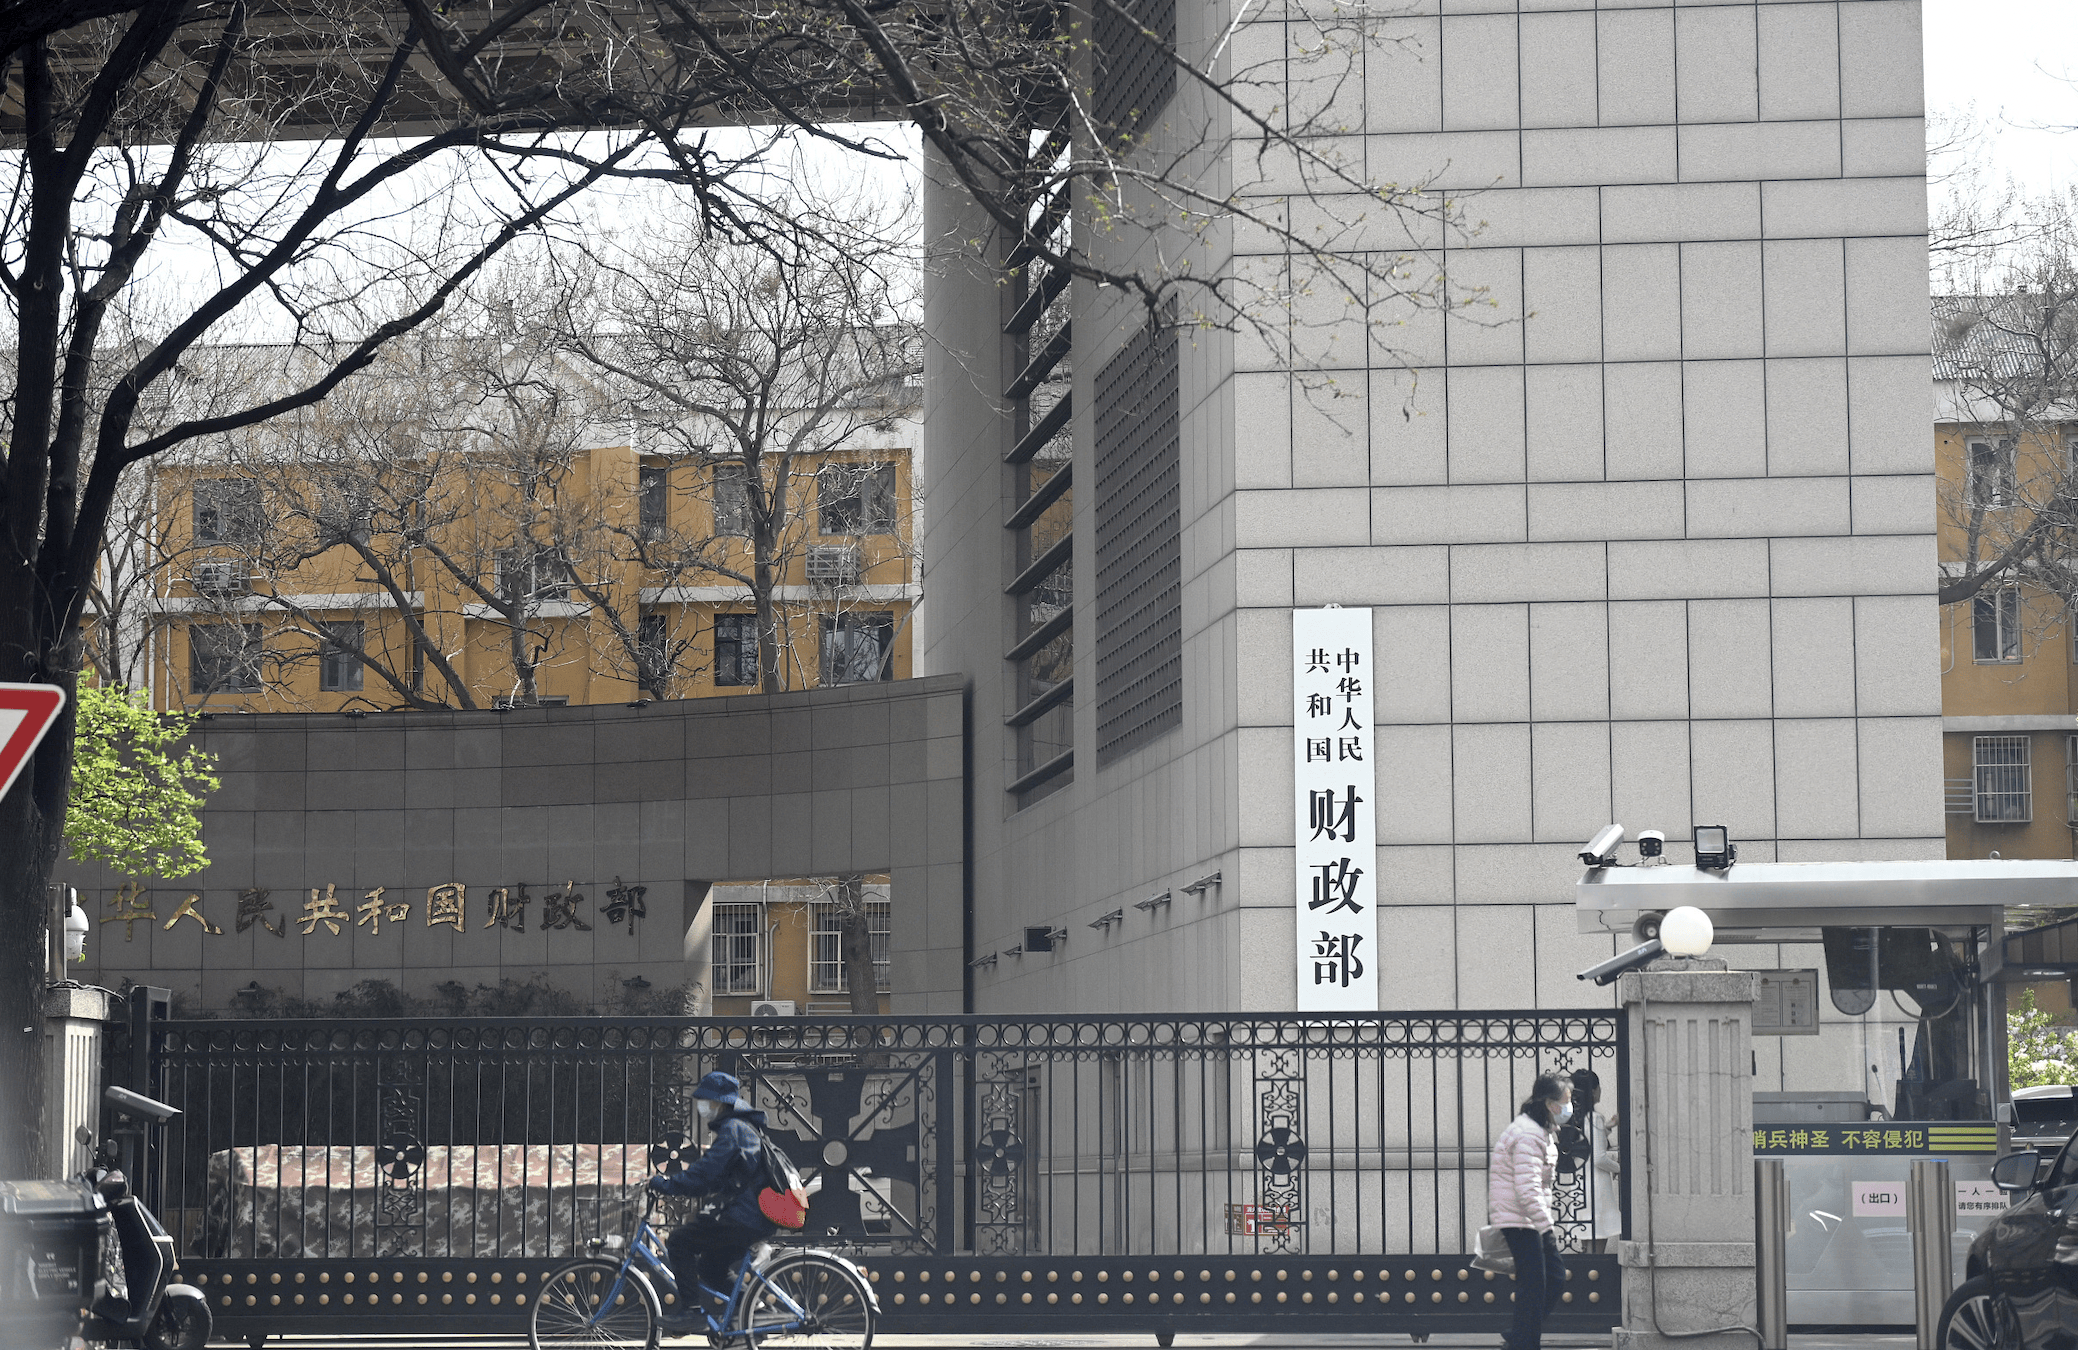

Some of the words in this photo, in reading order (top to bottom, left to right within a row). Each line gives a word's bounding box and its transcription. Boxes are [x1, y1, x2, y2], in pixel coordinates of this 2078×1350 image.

[1306, 648, 1331, 762] 共和国
[1337, 648, 1363, 762] 中华人民
[78, 876, 648, 942] 华人民共和国财政部
[1308, 784, 1364, 988] 财政部
[1841, 1129, 1924, 1149] 不容侵犯
[1958, 1201, 2008, 1210] 请您有序排队
